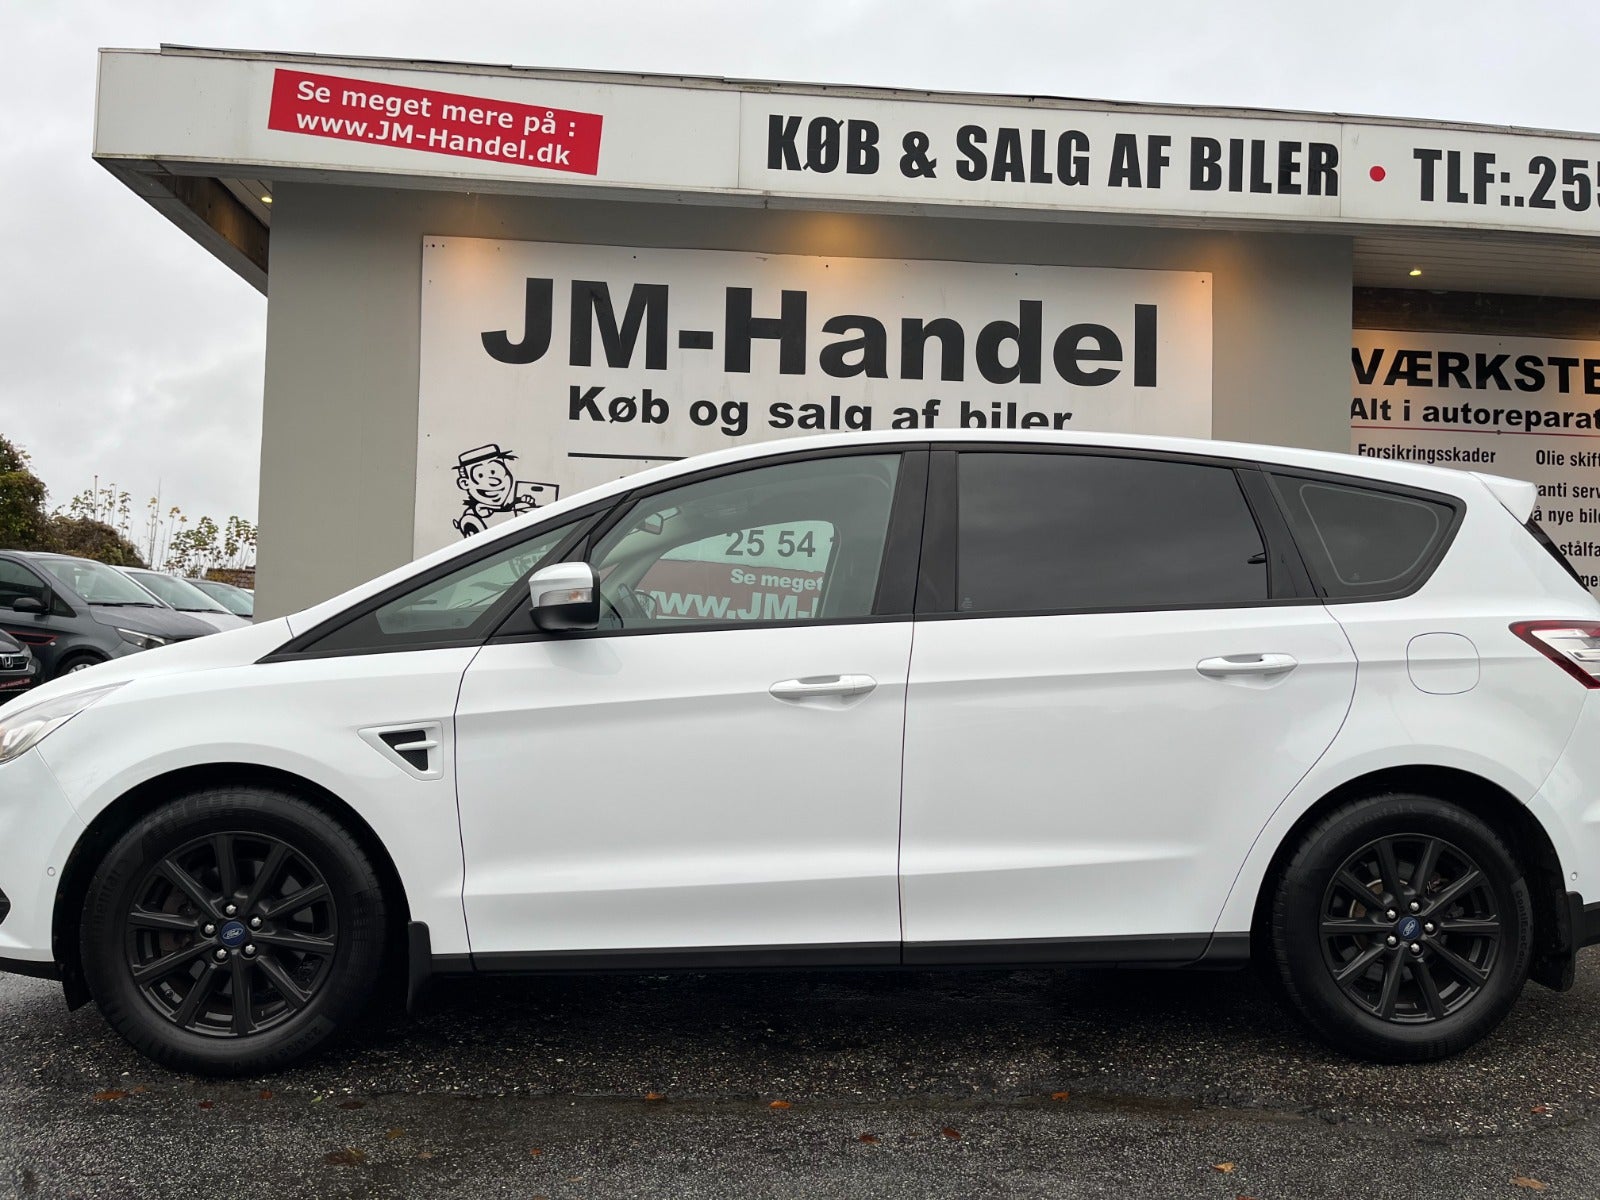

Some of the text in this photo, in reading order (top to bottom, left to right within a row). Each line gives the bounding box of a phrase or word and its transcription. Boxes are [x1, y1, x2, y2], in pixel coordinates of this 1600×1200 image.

[297, 80, 331, 103] Se
[342, 90, 432, 118] meget
[442, 103, 514, 129] mere
[524, 111, 557, 136] på
[296, 112, 571, 166] www.JM-Handel.dk
[767, 115, 1338, 197] KØB & SALG AF BILER
[481, 277, 1158, 388] JM-Handel
[569, 386, 1073, 436] Køb og salg af biler
[1351, 398, 1391, 421] Alt
[1404, 400, 1410, 421] i
[1358, 444, 1496, 464] Forsikringsskader
[1536, 450, 1565, 466] Olie
[1535, 482, 1567, 498] anti
[1530, 505, 1600, 526] å nye bil
[725, 529, 816, 557] 25 54
[730, 568, 823, 593] Se meget
